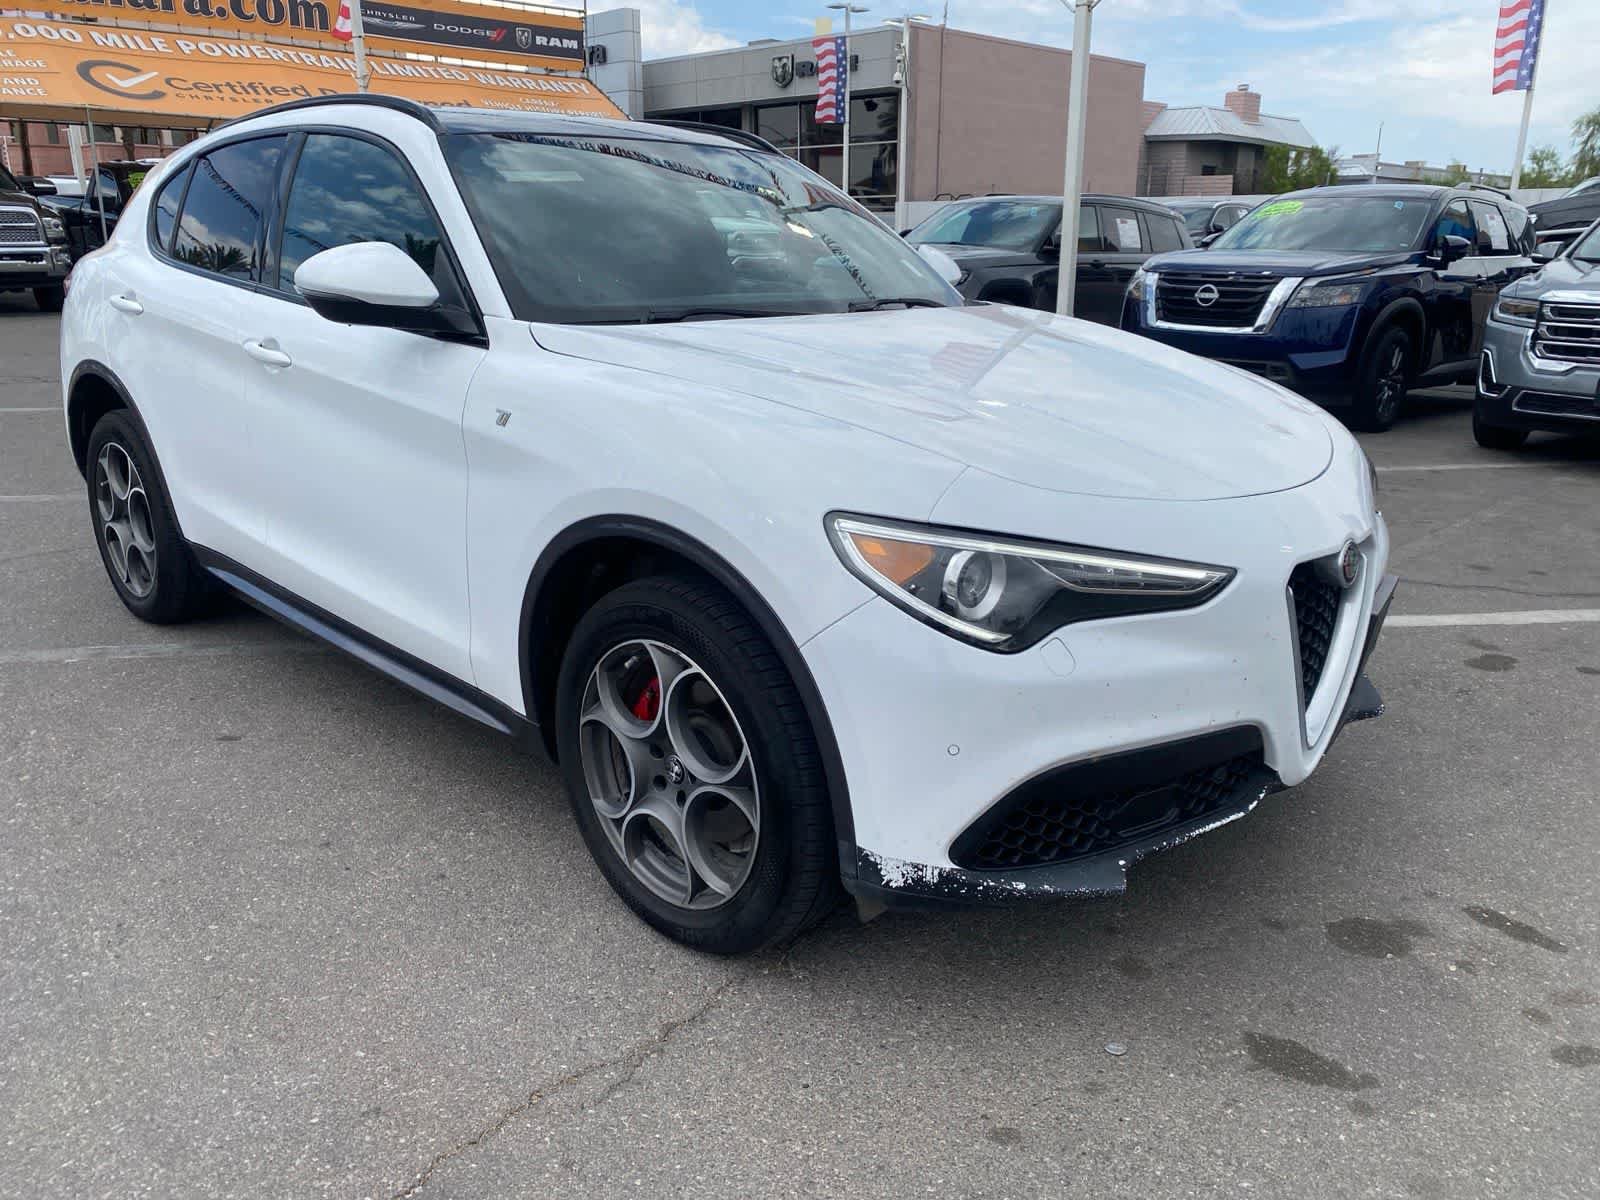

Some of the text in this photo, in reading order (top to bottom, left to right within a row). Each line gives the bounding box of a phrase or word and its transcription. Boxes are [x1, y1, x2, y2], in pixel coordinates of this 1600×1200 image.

[433, 23, 498, 38] DODGE
[535, 35, 578, 49] RAM
[88, 30, 174, 54] MILE
[369, 60, 470, 82] LIMITED
[470, 70, 590, 95] WARRANTY
[3, 77, 40, 85] AND
[164, 77, 312, 98] Certified
[175, 92, 274, 104] CHRYSLER
